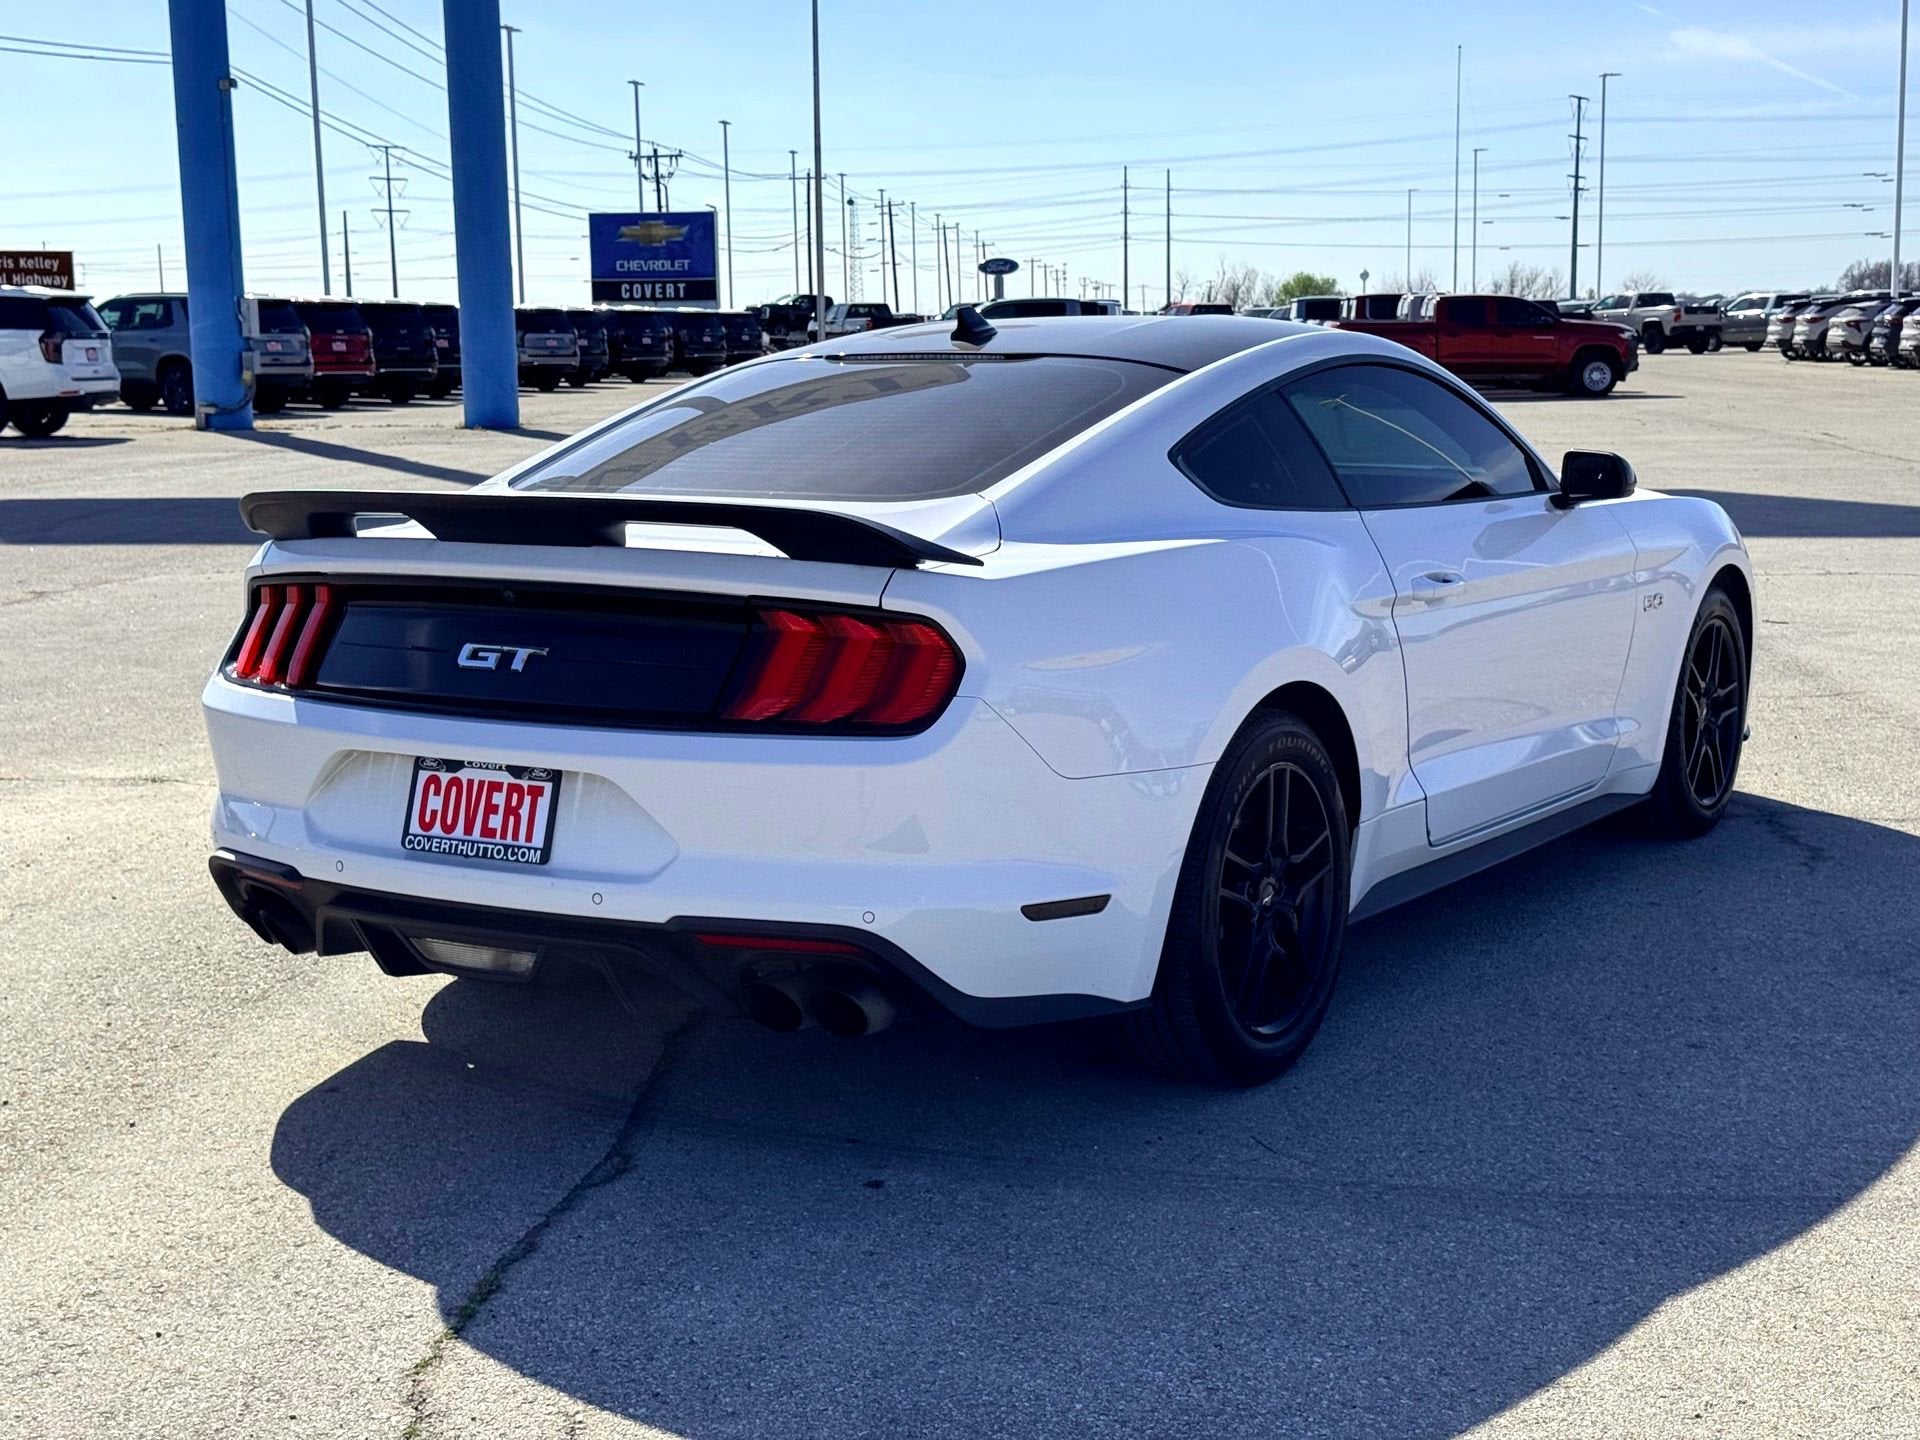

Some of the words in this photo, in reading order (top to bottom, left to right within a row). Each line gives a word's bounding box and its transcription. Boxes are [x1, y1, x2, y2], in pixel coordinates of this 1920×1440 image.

[19, 256, 60, 272] Kelley
[615, 259, 691, 271] CHEVROLET
[12, 272, 69, 289] Highway
[621, 282, 687, 299] COVERT
[457, 642, 550, 673] GT
[464, 760, 508, 771] Covert
[417, 773, 546, 844] COVERT
[404, 835, 542, 864] COVERTHUTTO.COM
